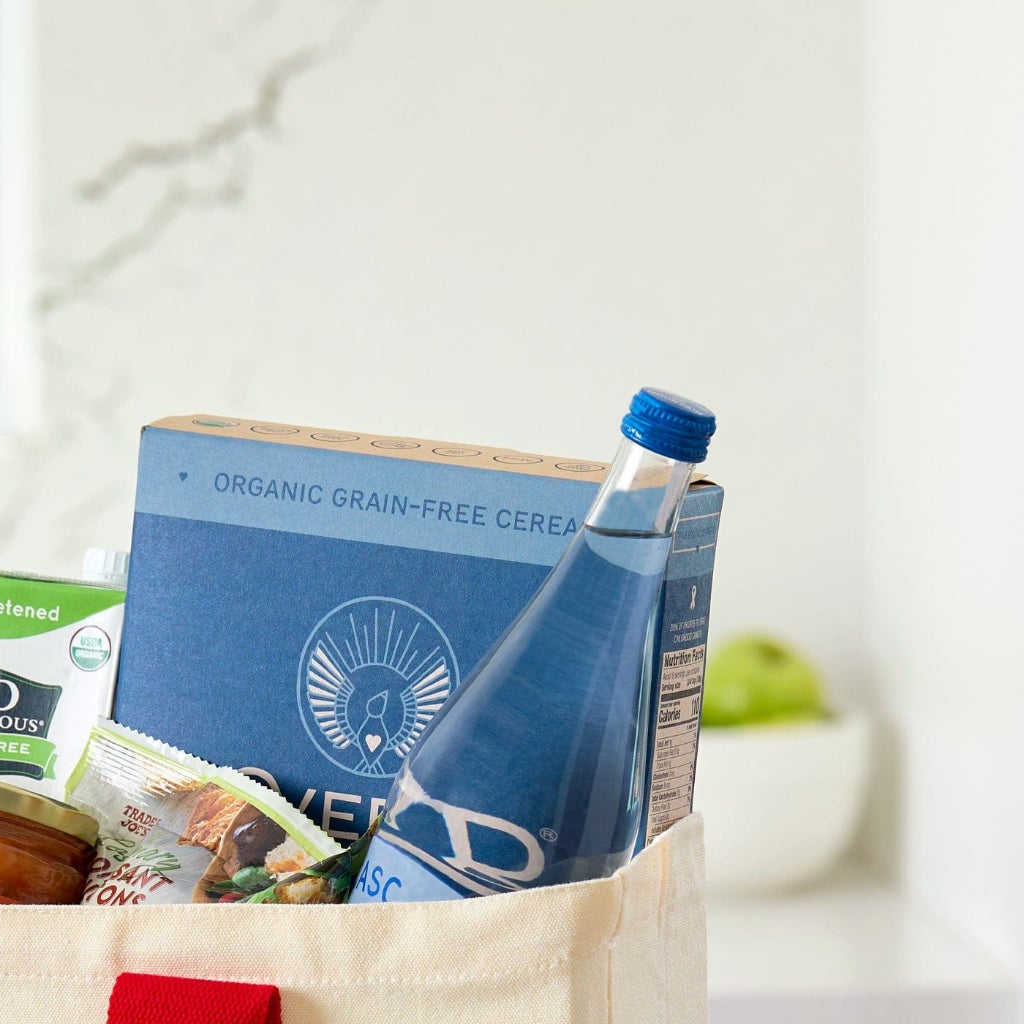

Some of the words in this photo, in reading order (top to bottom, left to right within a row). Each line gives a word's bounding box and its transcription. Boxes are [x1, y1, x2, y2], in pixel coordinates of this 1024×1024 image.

[214, 472, 323, 505] ORGANIC
[332, 487, 487, 526] GRAIN-FREE
[495, 509, 579, 538] CEREA
[80, 636, 103, 648] USDA
[75, 649, 105, 660] ORGANIC
[664, 651, 691, 667] Nutrition
[692, 648, 704, 662] Facts
[659, 709, 681, 723] Calories
[121, 819, 151, 836] JOE'S
